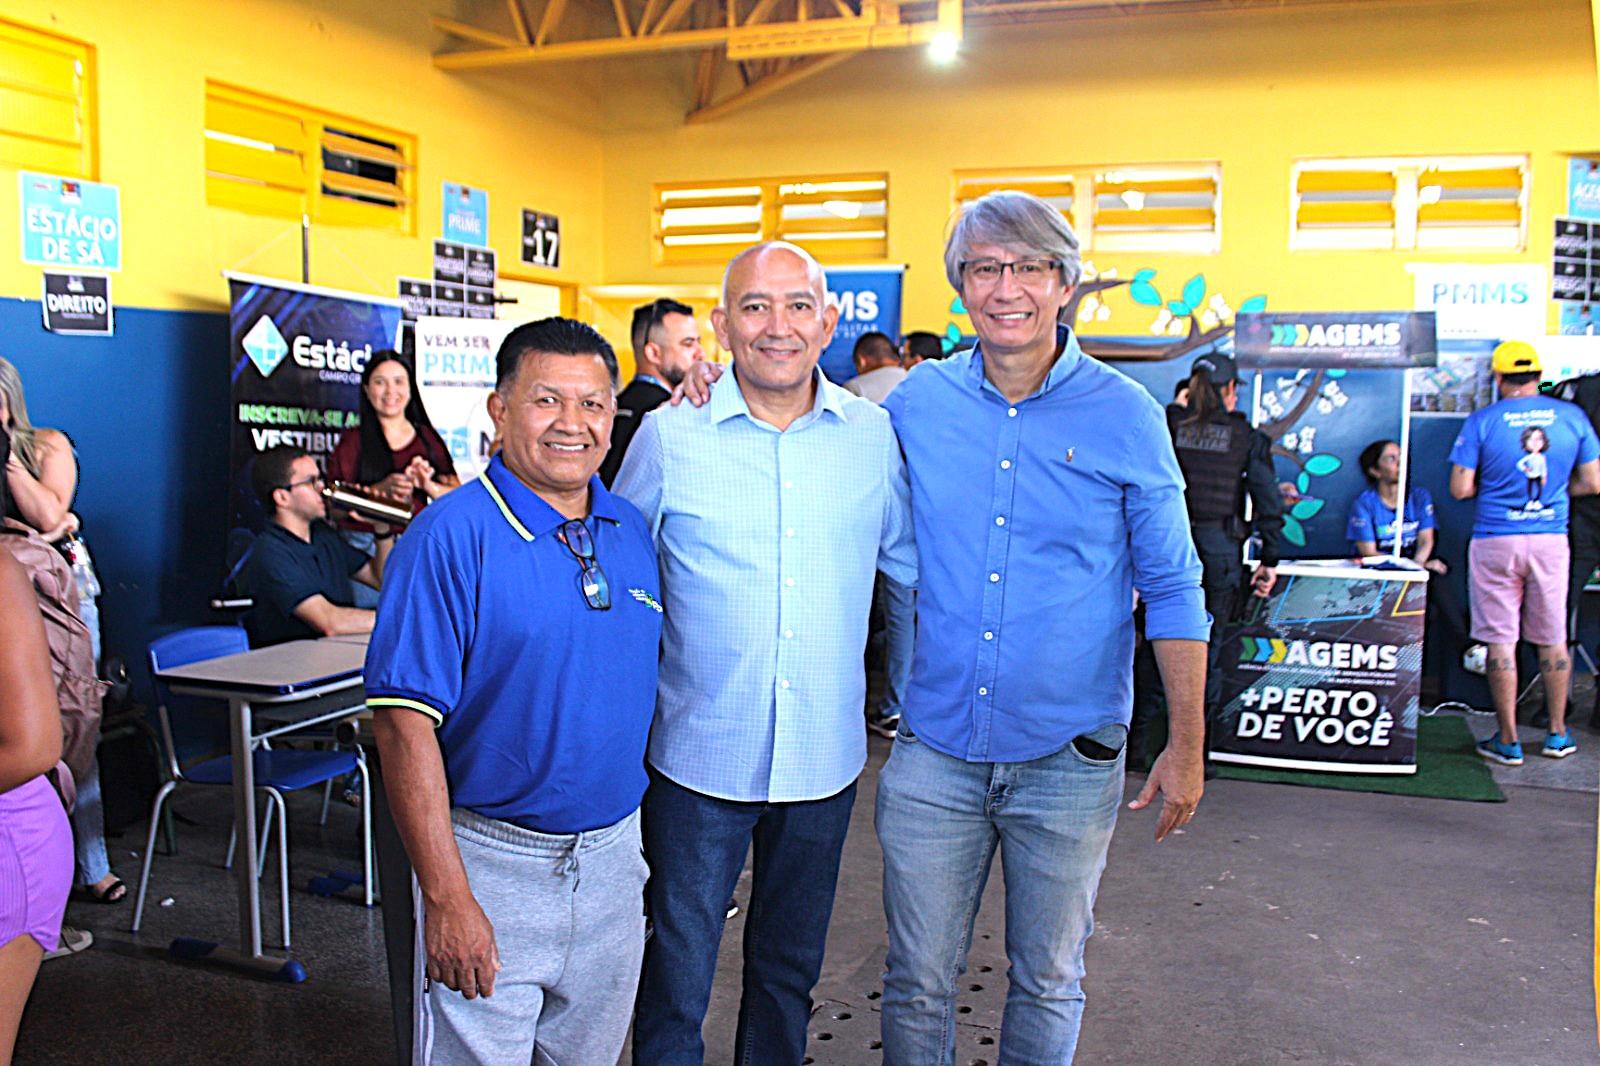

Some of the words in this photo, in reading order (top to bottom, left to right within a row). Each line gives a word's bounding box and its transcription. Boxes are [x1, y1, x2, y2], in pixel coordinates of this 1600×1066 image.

[27, 207, 117, 241] ESTÁCIO
[42, 236, 71, 262] DE
[533, 229, 558, 265] 17
[47, 293, 106, 314] DIREITO
[1433, 282, 1529, 304] PMMS
[424, 334, 458, 348] VEM
[464, 335, 490, 350] SER
[1307, 322, 1401, 347] AGEMS
[424, 352, 496, 375] PRIM
[319, 370, 348, 383] CAMPO
[239, 404, 343, 426] INSCREVA-SE
[1285, 640, 1398, 670] AGEMS
[1240, 686, 1377, 717] +PERTO
[1237, 712, 1285, 740] DE
[1294, 712, 1393, 746] VOCÊ
